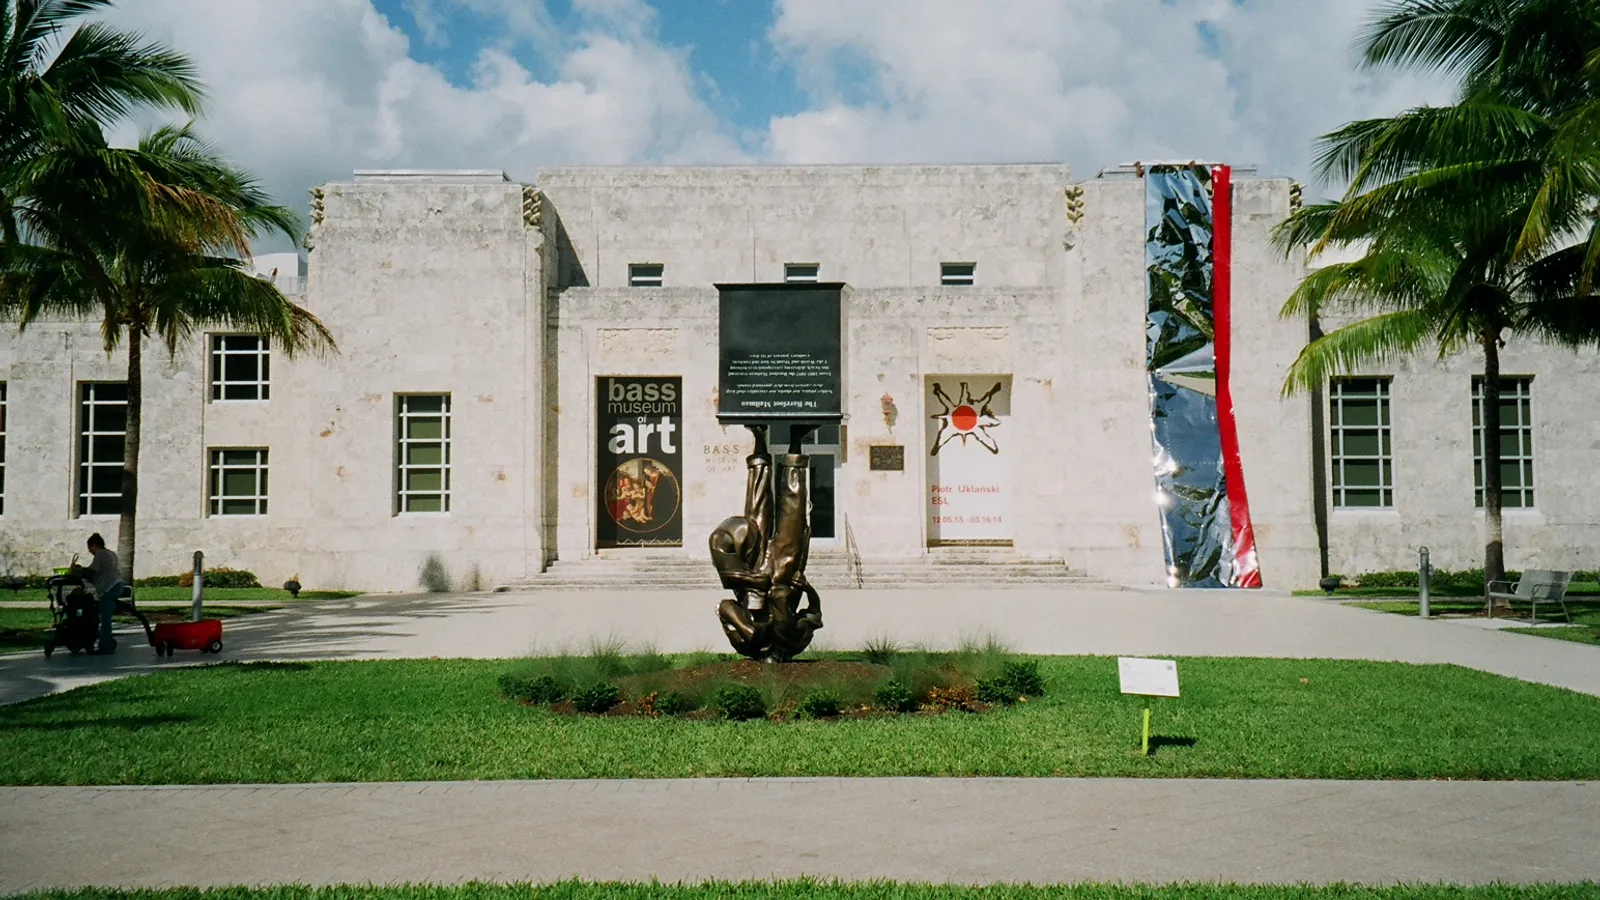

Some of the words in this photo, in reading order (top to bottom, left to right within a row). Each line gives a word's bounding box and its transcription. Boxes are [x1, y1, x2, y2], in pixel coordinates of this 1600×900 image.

[608, 378, 676, 402] bass
[608, 402, 676, 414] museum
[637, 414, 647, 424] of
[608, 416, 676, 454] art
[704, 445, 739, 454] BASS
[932, 485, 952, 493] Piotr
[932, 497, 949, 505] ESL
